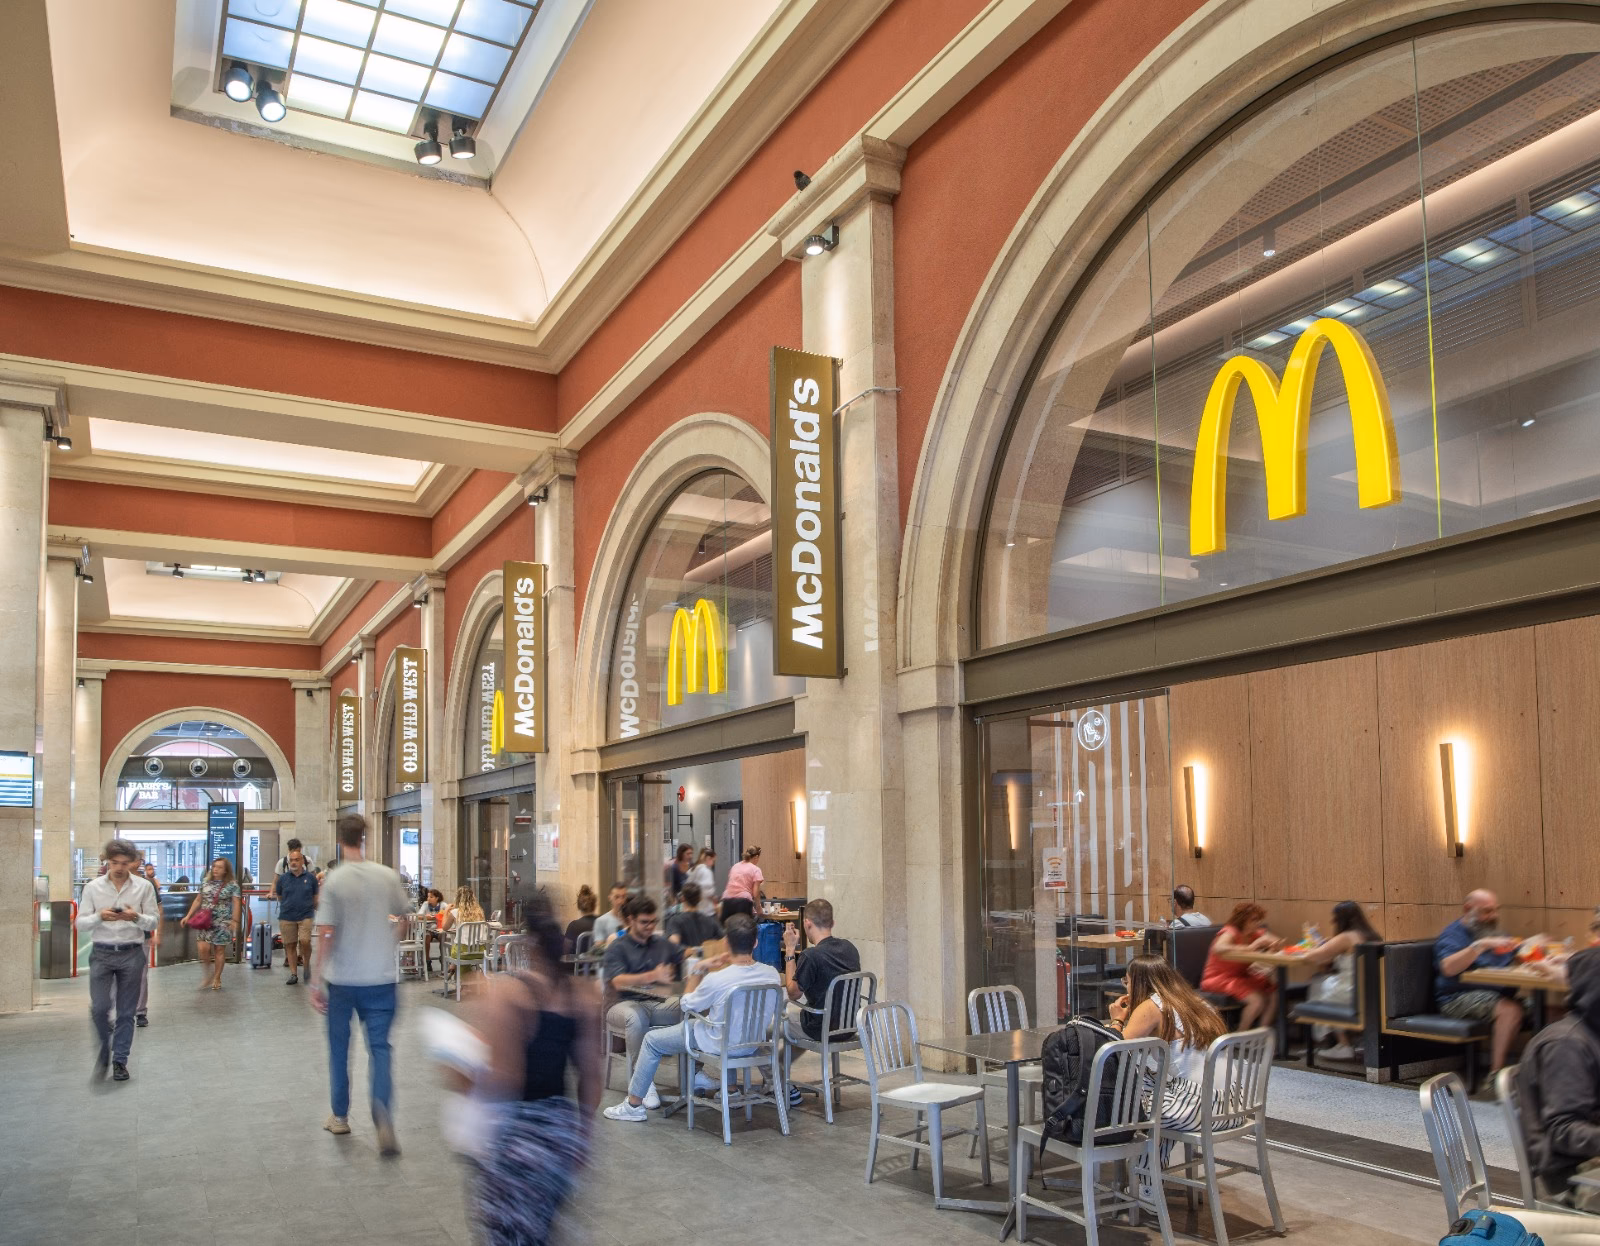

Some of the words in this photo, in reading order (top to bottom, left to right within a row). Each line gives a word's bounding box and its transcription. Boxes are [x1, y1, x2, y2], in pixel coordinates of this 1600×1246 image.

[789, 377, 824, 650] McDonald's
[514, 577, 535, 737] McDonald's
[403, 657, 418, 700] WEST
[342, 703, 354, 737] WEST
[403, 702, 418, 740] WILD
[342, 737, 354, 767] WILD
[403, 741, 418, 773] OLD
[139, 791, 159, 799] BAR
[342, 768, 354, 793] OLD
